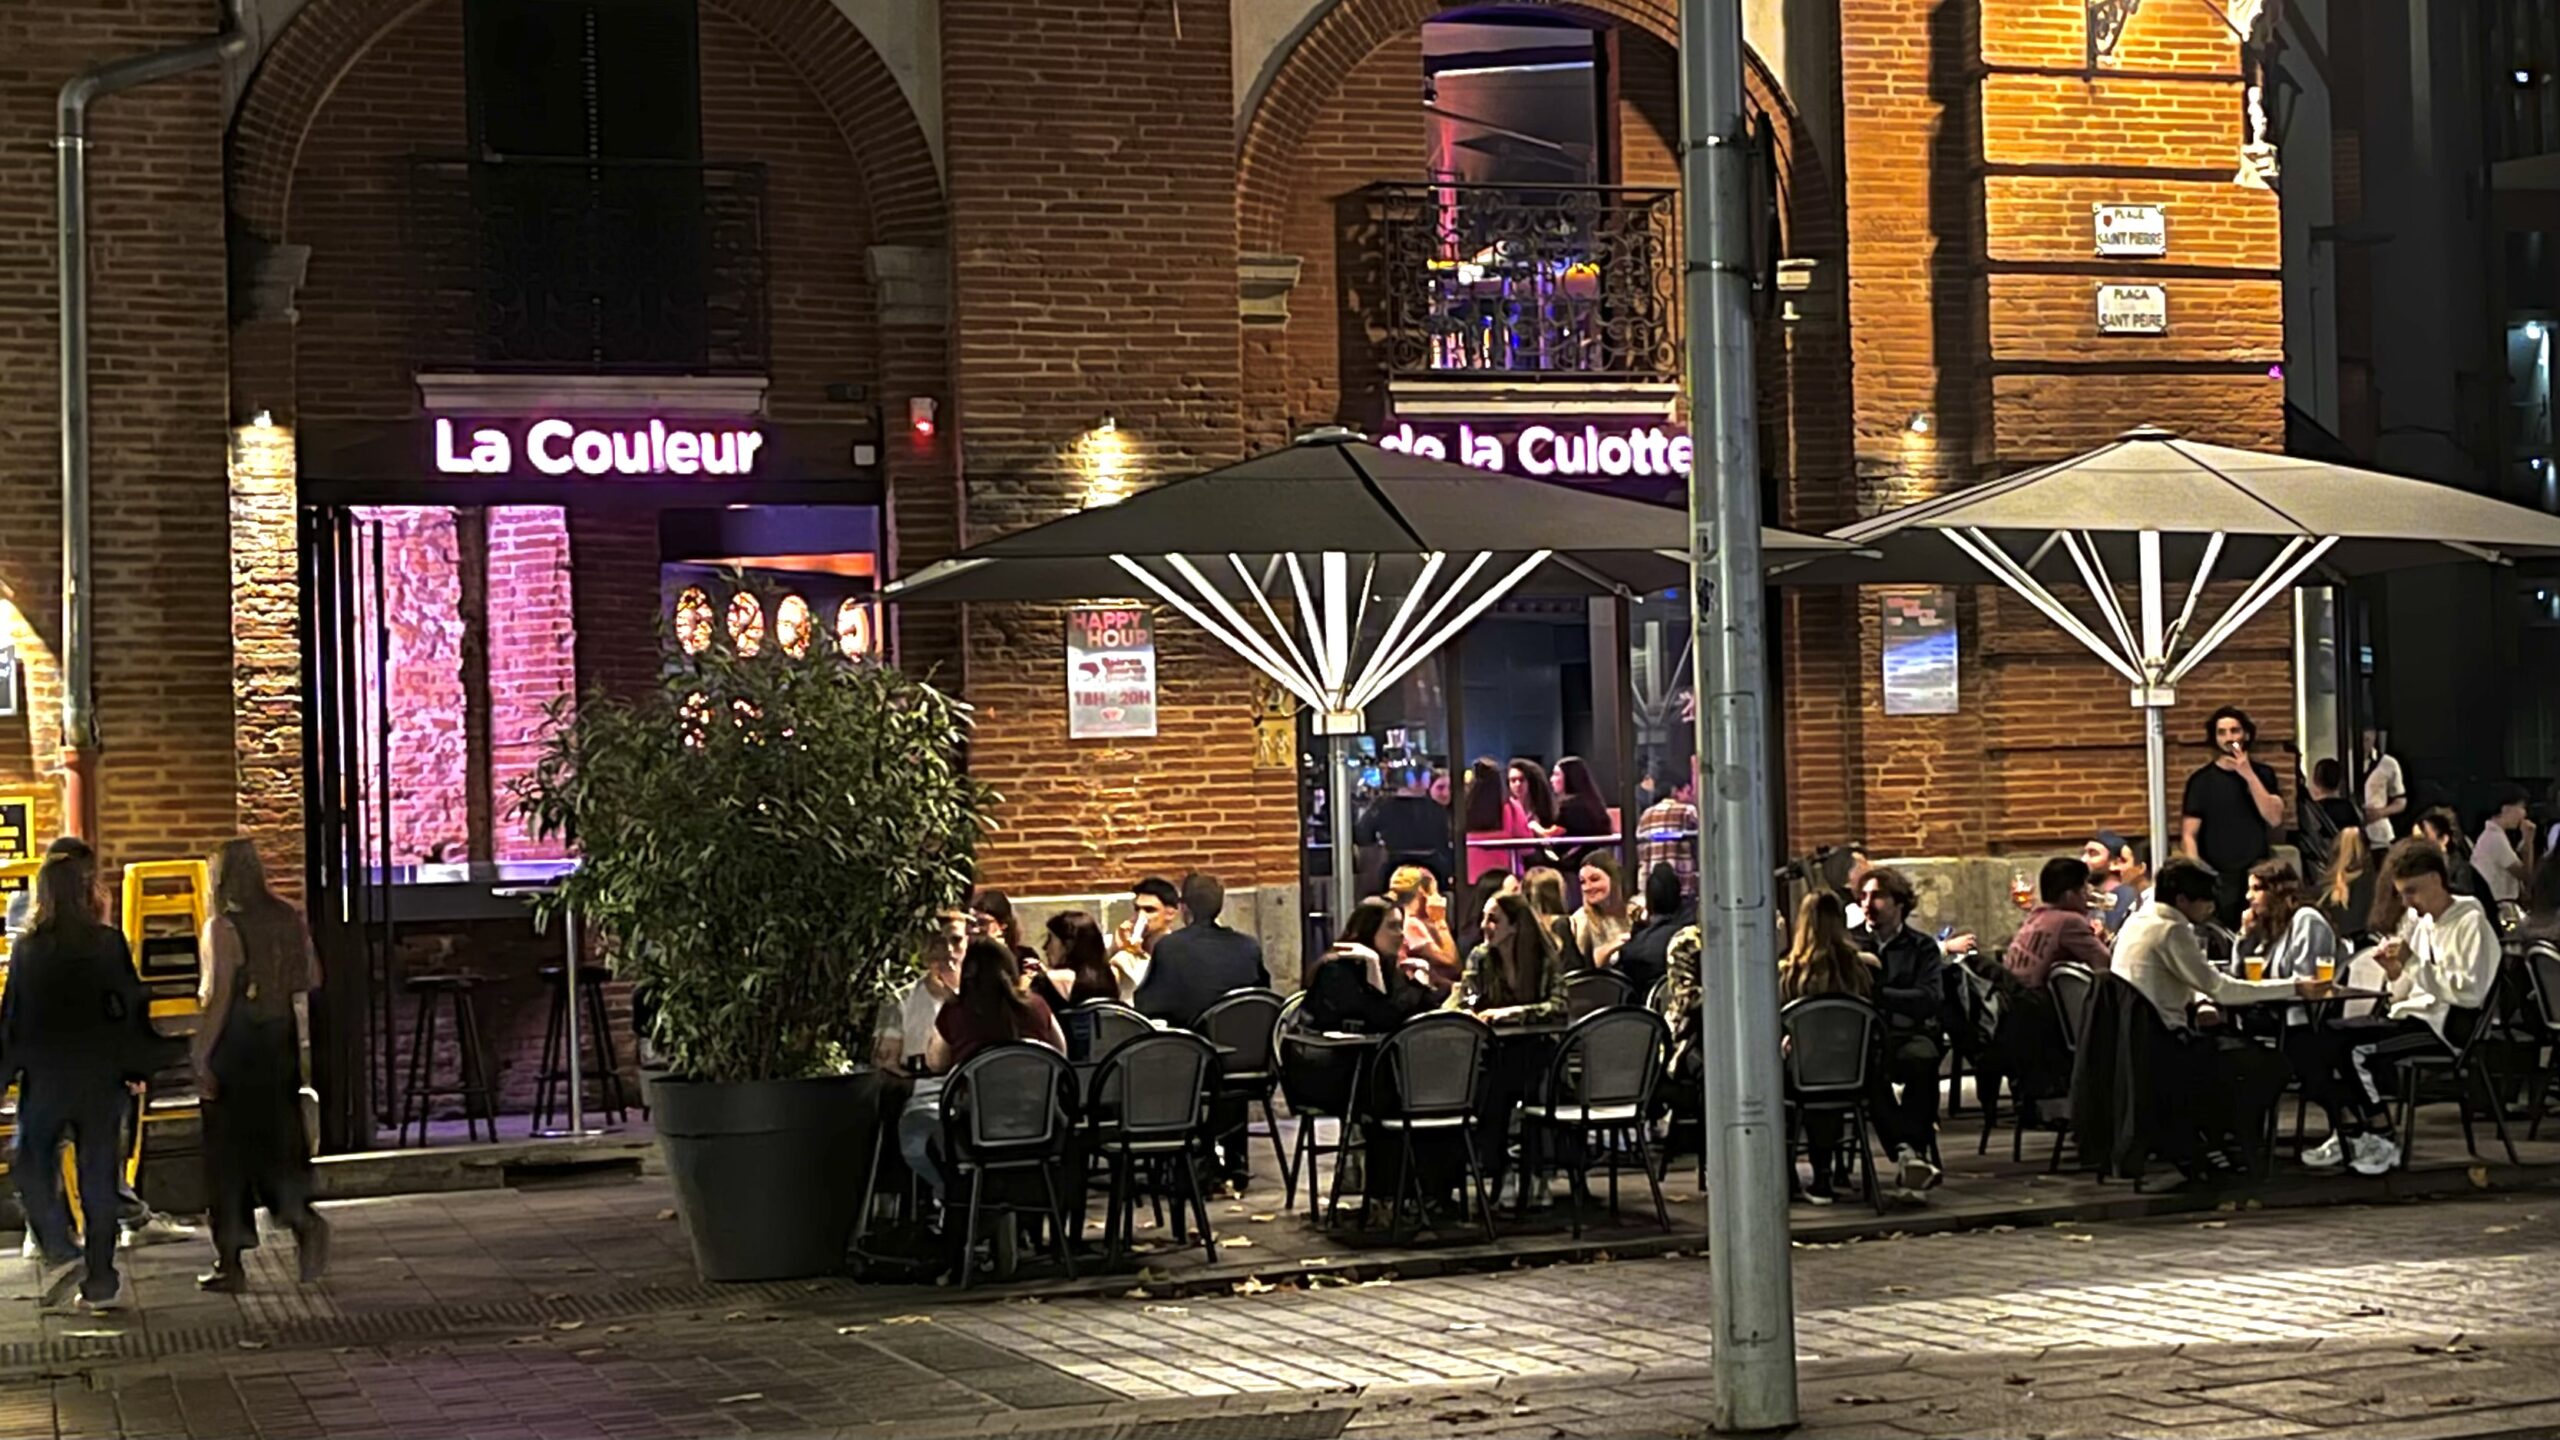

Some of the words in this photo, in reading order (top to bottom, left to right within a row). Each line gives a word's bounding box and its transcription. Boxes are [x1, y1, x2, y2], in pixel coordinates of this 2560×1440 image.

[2097, 232, 2127, 245] SAINT
[2129, 232, 2162, 245] PIERRE
[2101, 313, 2130, 327] SANT
[435, 418, 512, 473] La
[527, 418, 763, 474] Couleur
[1460, 425, 1504, 471] la
[1518, 425, 1693, 475] Culotte
[1071, 611, 1142, 629] HAPPY
[1087, 629, 1148, 648] HOUR
[1074, 691, 1106, 705] 18H
[1120, 690, 1151, 705] 20H
